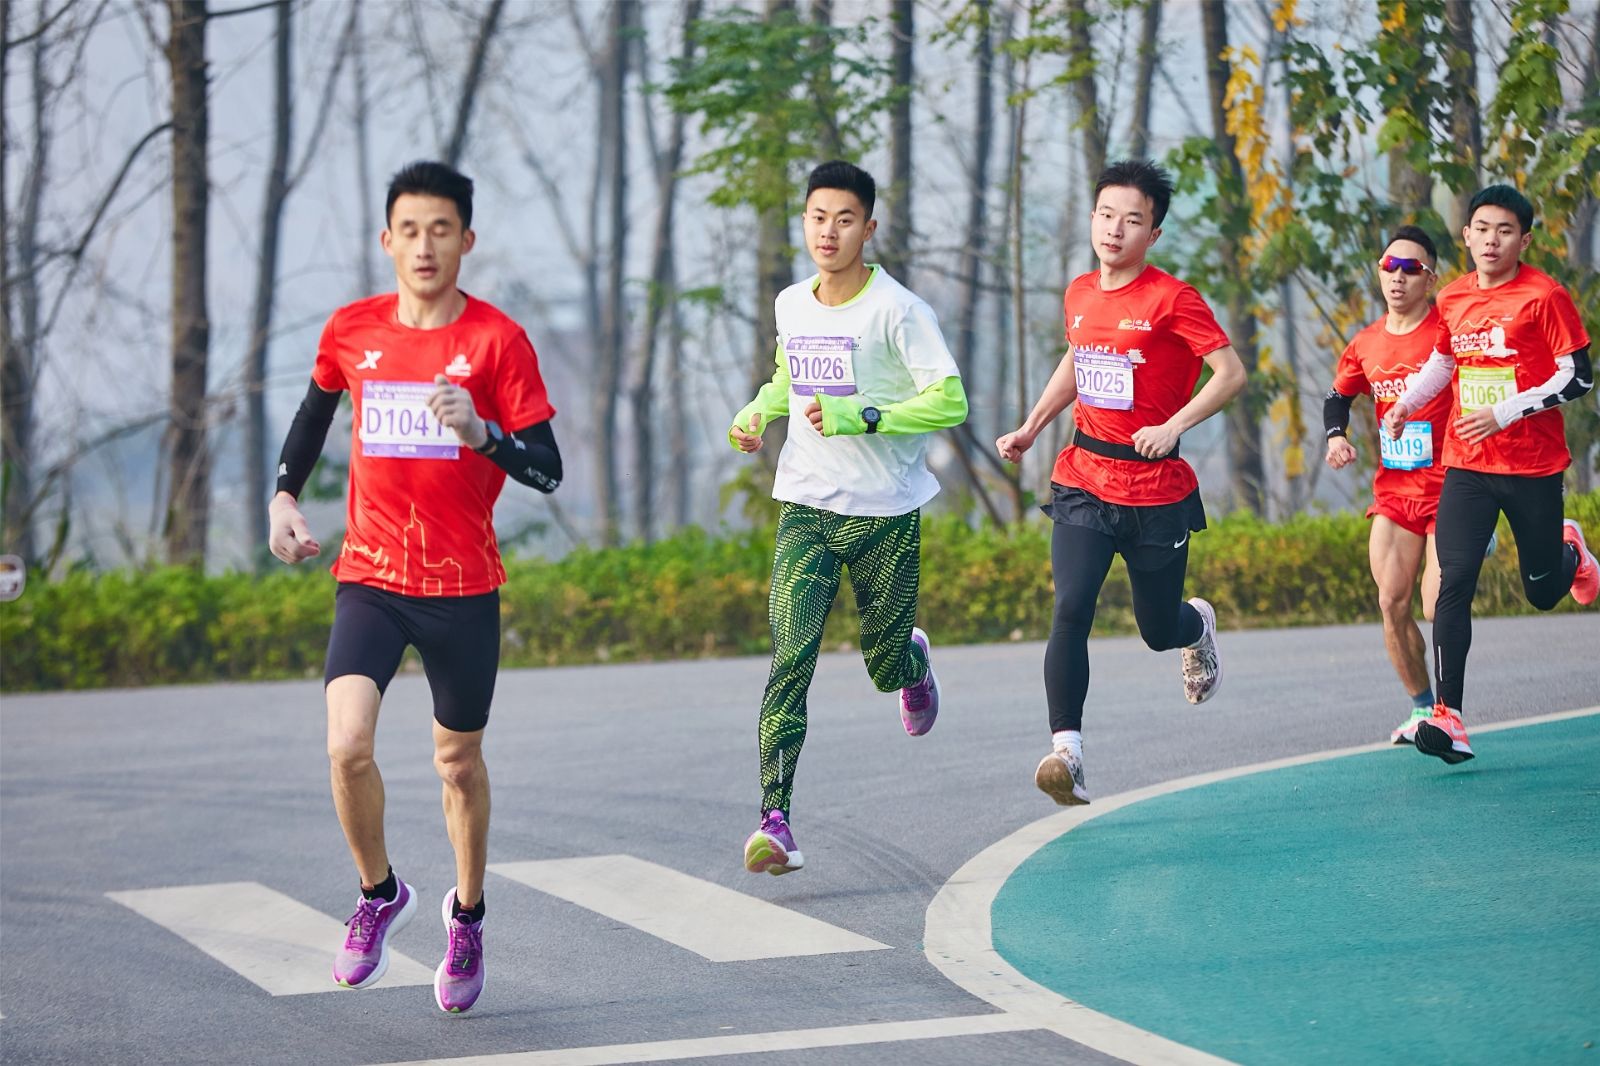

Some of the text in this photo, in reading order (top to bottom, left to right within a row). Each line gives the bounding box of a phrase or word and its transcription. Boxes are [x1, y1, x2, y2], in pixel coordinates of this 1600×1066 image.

[788, 355, 844, 380] D1026
[1076, 367, 1125, 394] D1025
[1461, 383, 1506, 405] C1061
